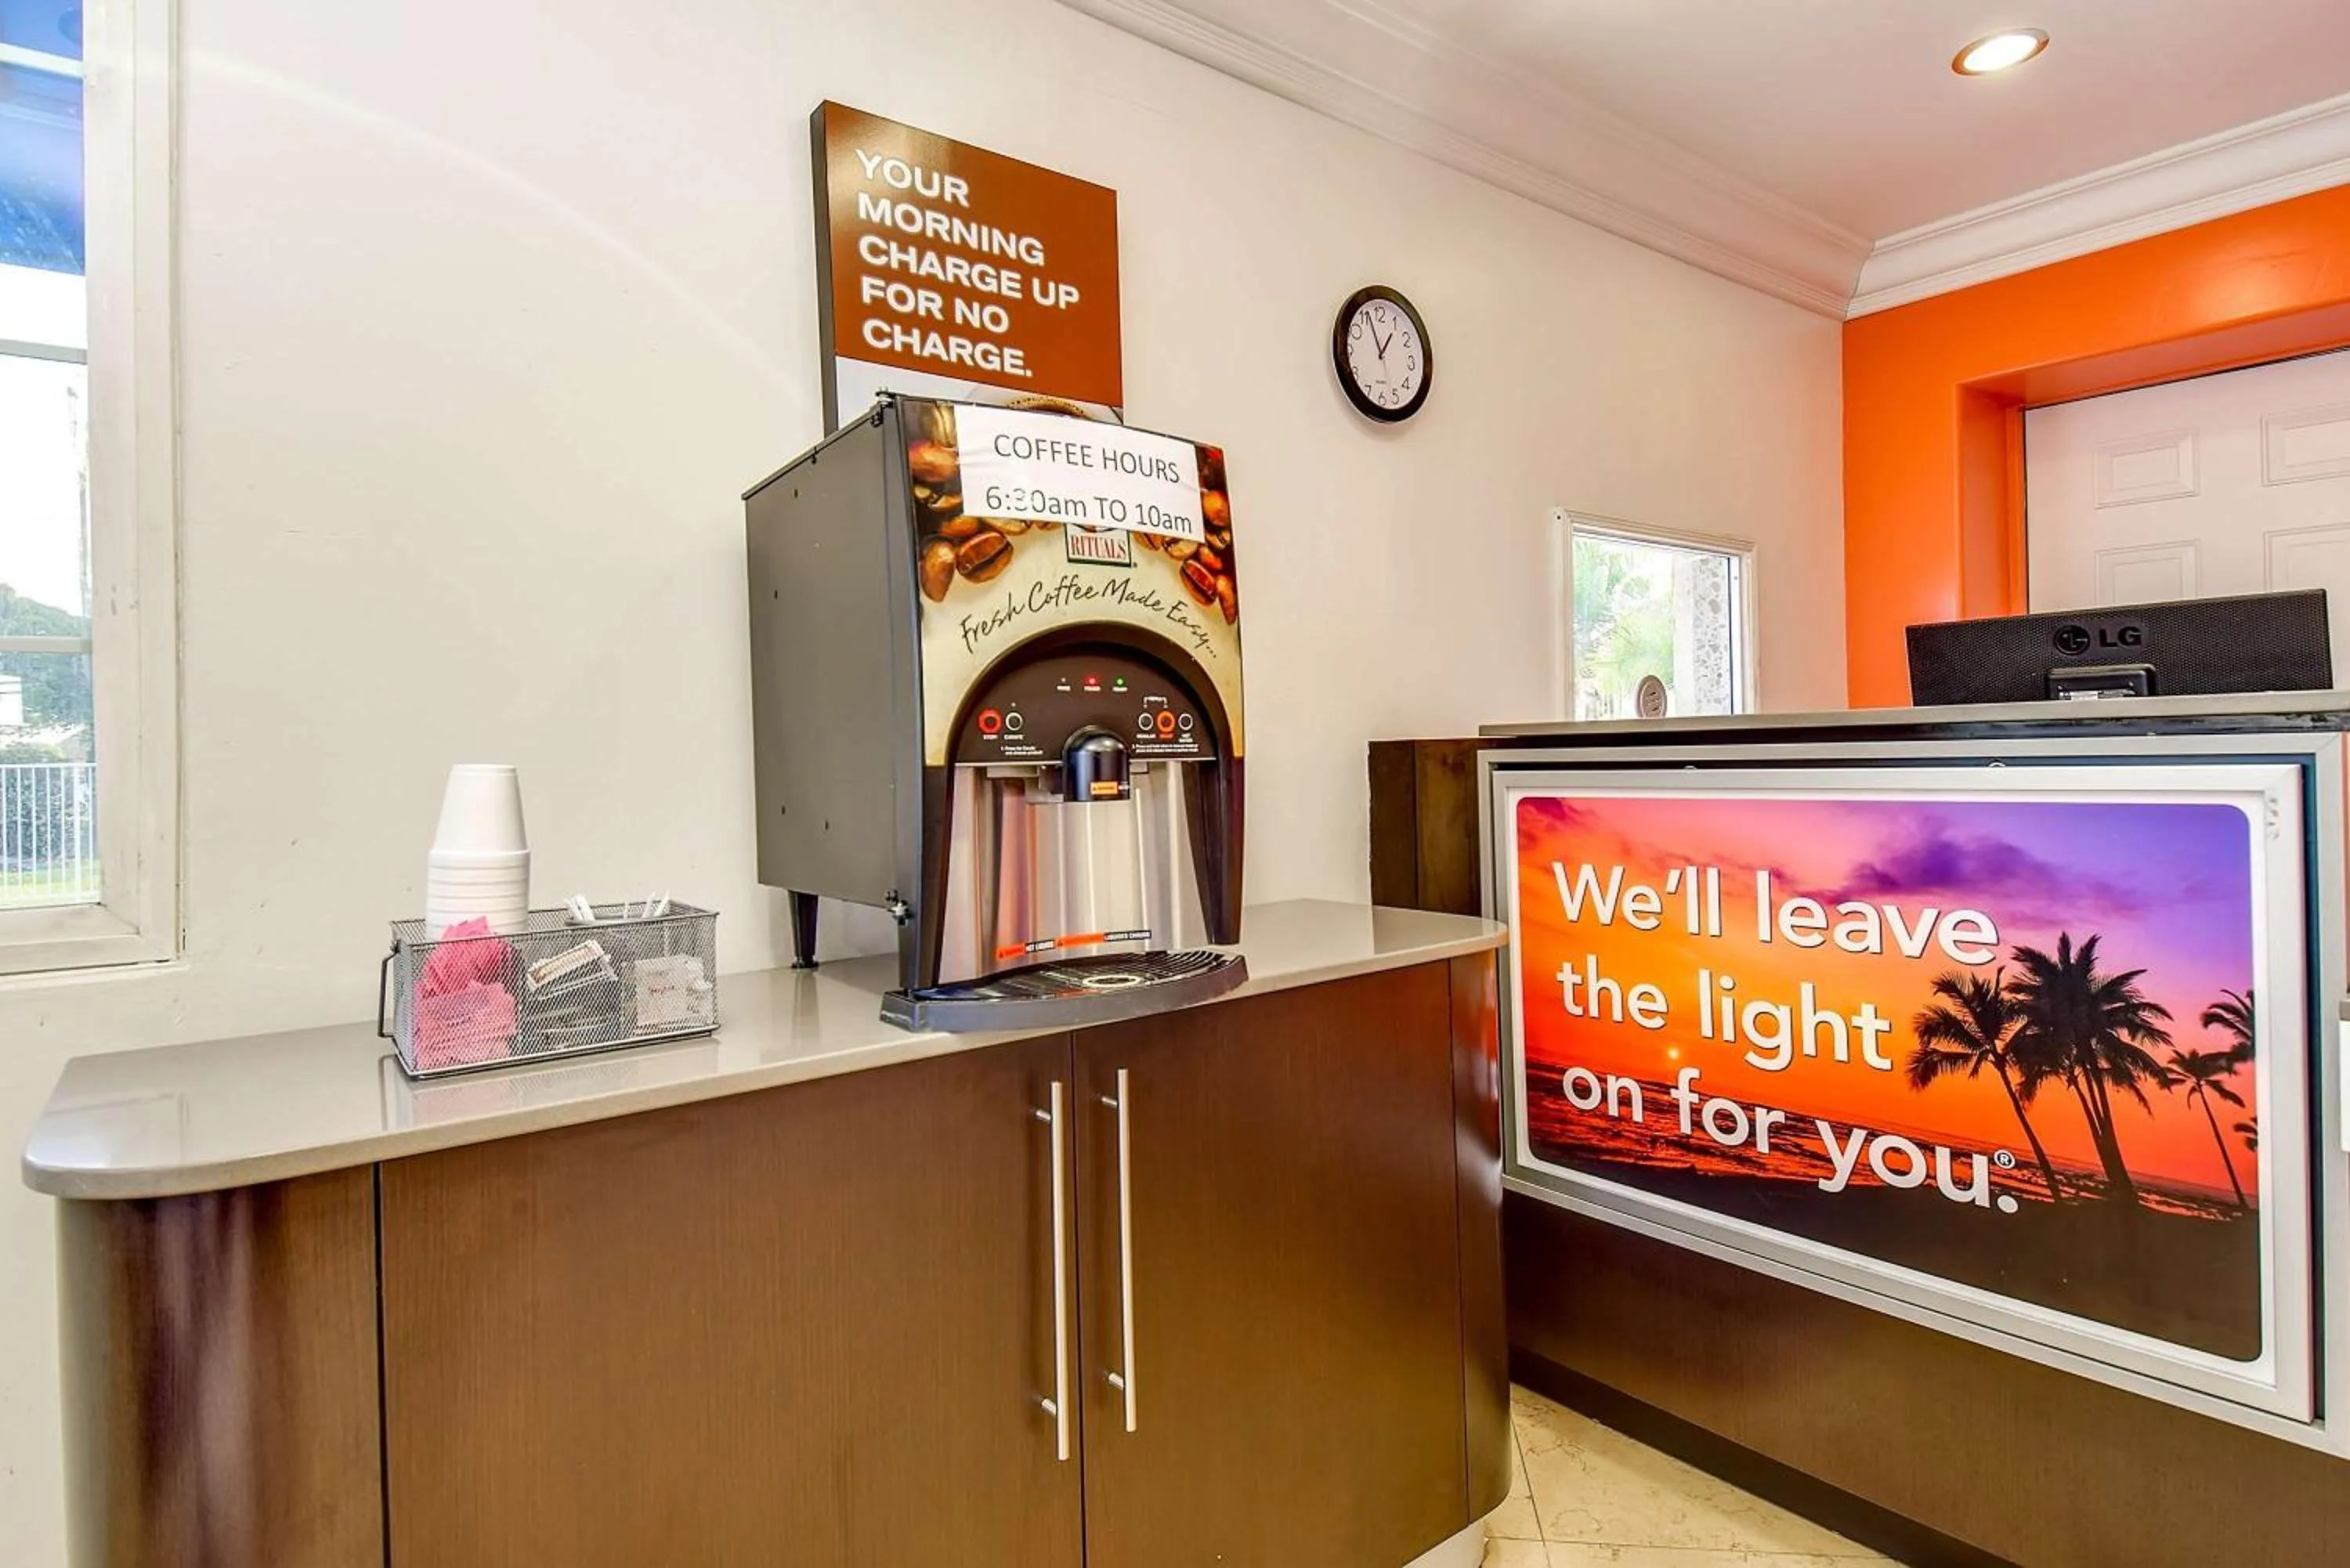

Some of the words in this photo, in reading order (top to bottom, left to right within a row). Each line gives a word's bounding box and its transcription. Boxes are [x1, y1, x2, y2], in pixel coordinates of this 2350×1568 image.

[855, 149, 969, 207] YOUR
[858, 192, 1045, 266] MORNING
[859, 234, 1022, 299] CHARGE
[1032, 277, 1079, 309] UP
[862, 274, 943, 320] FOR
[954, 297, 1010, 334] NO
[1373, 306, 1386, 323] 12
[1392, 316, 1397, 331] 1
[862, 317, 1034, 378] CHARGE.
[1401, 331, 1412, 349] 2
[1407, 355, 1416, 372] 3
[1364, 384, 1372, 397] 7
[1377, 391, 1387, 406] 6
[1390, 388, 1400, 405] 5
[1401, 377, 1411, 391] 4
[993, 433, 1094, 468] COFFEE
[1102, 447, 1180, 484] HOURS
[985, 485, 1087, 518] 6:30am
[1094, 496, 1128, 522] TO
[1135, 503, 1193, 535] 10am
[1070, 534, 1127, 560] RITUALS
[960, 591, 1026, 655] Fresh
[1027, 573, 1099, 614] Coffee
[1101, 577, 1166, 613] Made
[2099, 627, 2142, 648] LG
[1553, 862, 1721, 936] We'll
[1756, 869, 1999, 965] leave
[1556, 953, 1668, 1029] the
[1698, 968, 1893, 1071] light
[1563, 1067, 1643, 1123] on
[1671, 1068, 1784, 1154] for
